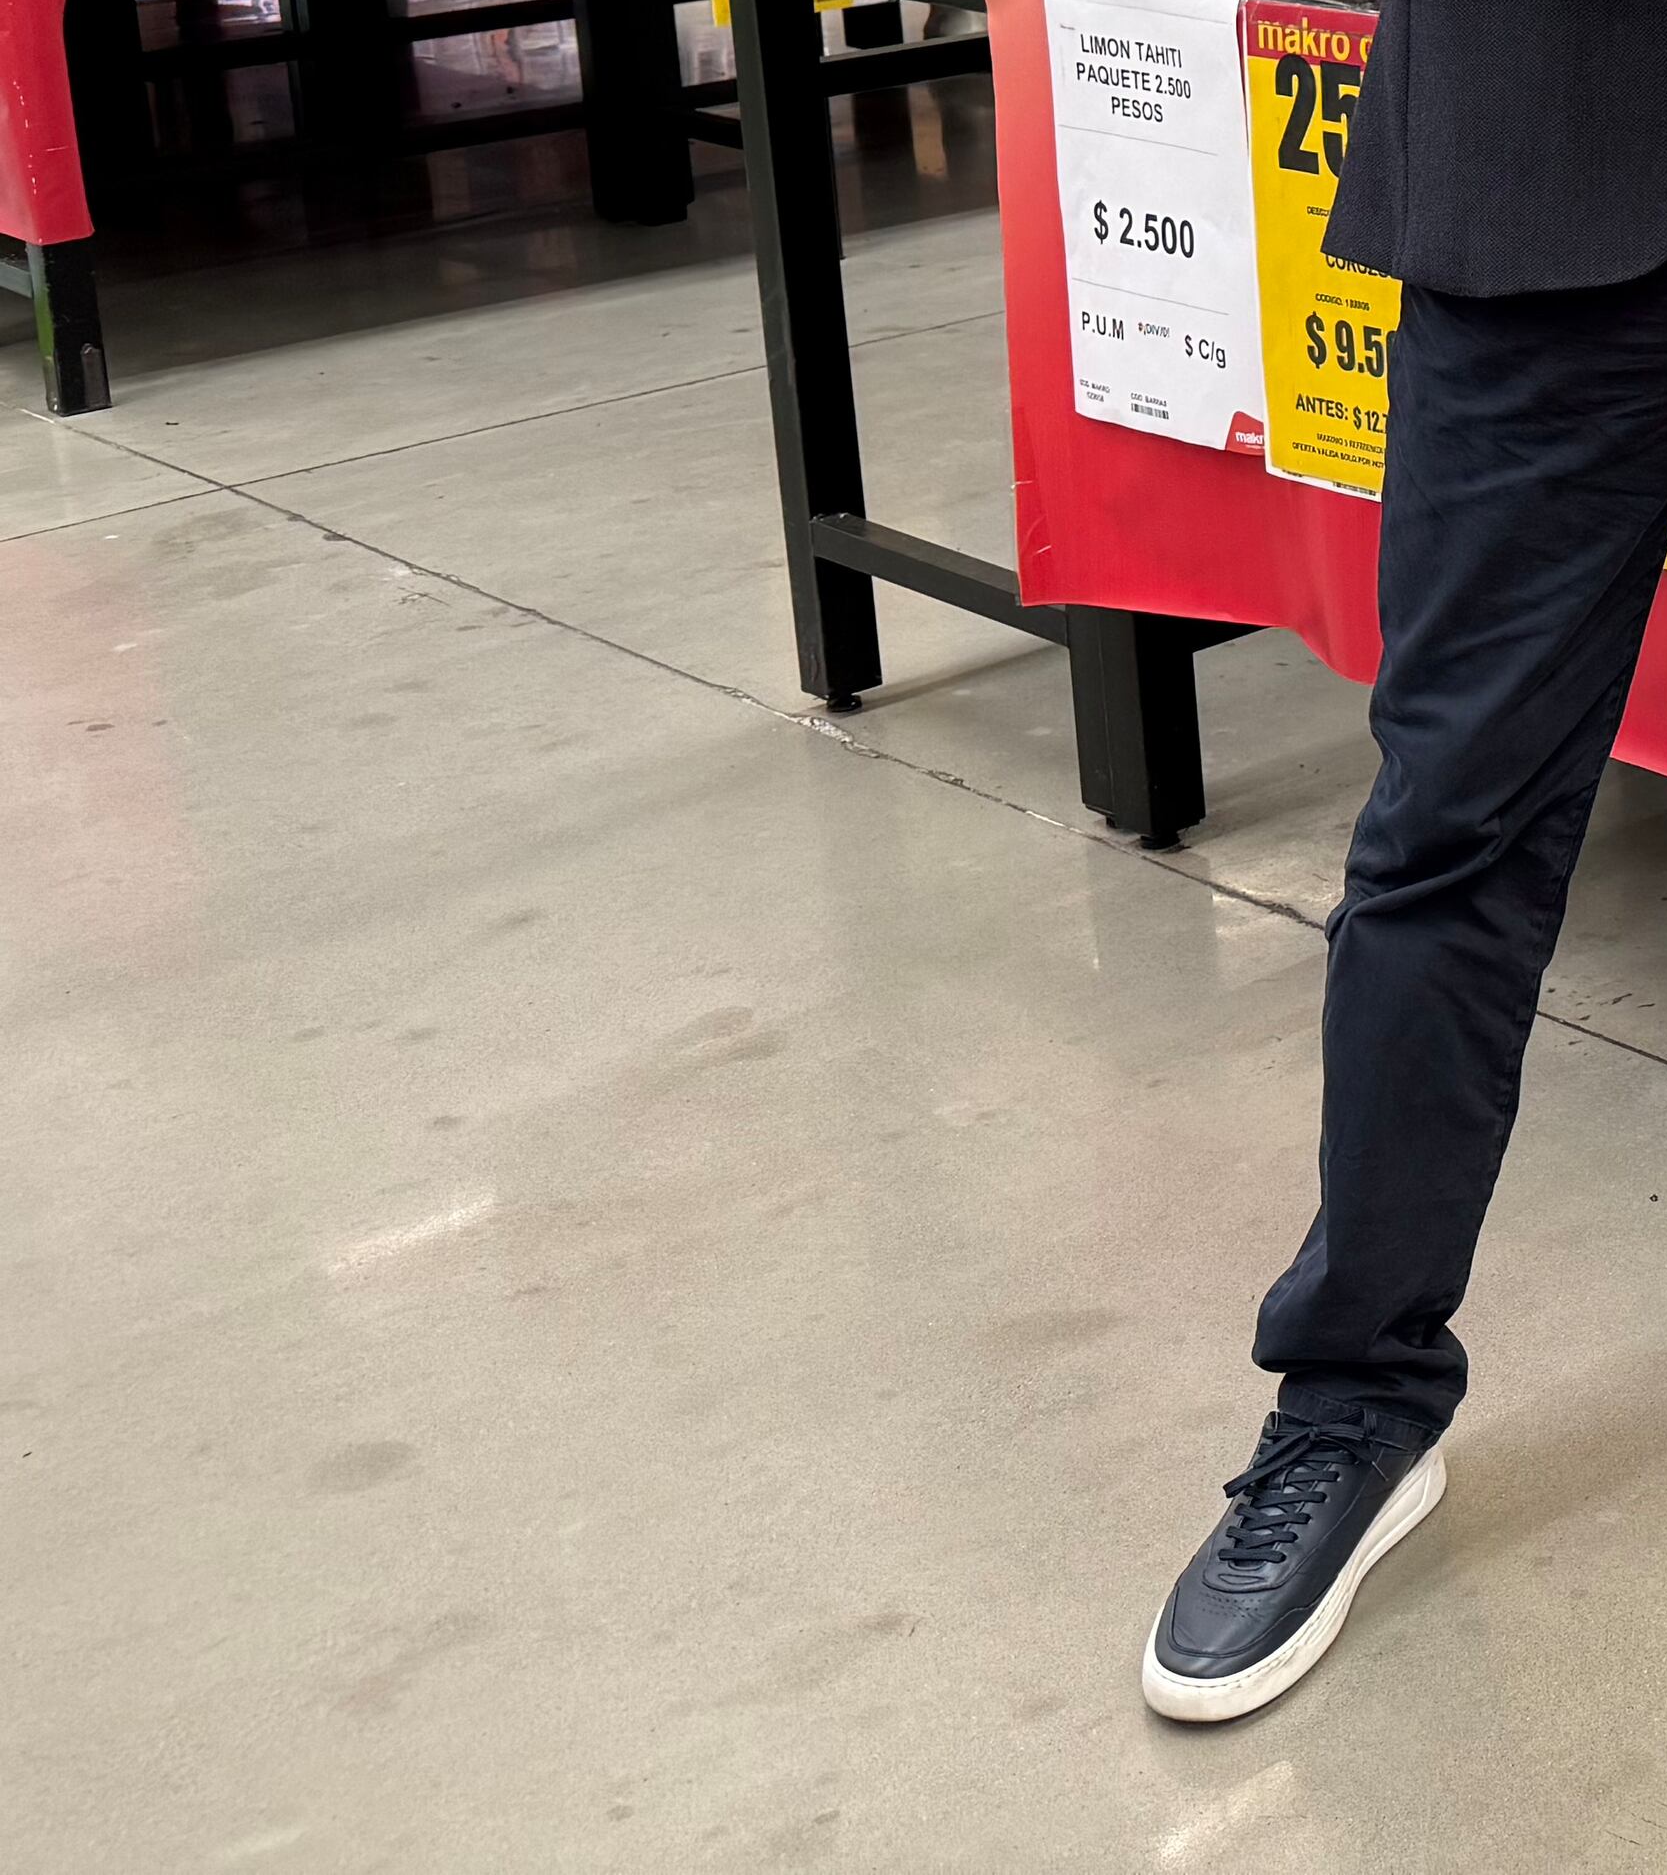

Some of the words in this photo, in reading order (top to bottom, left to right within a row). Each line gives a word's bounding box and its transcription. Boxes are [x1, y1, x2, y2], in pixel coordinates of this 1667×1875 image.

[1080, 33, 1131, 59] LIMON
[1135, 41, 1183, 69] TAHITI
[1257, 17, 1350, 61] makro
[1076, 62, 1151, 92] PAQUETE
[1155, 74, 1191, 99] 2.500
[1111, 96, 1163, 122] PESOS
[1275, 54, 1361, 178] 25
[1094, 200, 1109, 245] $
[1119, 207, 1195, 259] 2.500
[1081, 311, 1125, 341] P.U.M
[1184, 334, 1194, 357] $
[1198, 338, 1227, 369] C/g
[1305, 311, 1327, 369] $
[1335, 320, 1397, 378] 9.5
[1296, 393, 1348, 421] ANTES:
[1353, 406, 1362, 430] $
[1365, 410, 1388, 434] 12.7
[1235, 431, 1265, 445] makr
